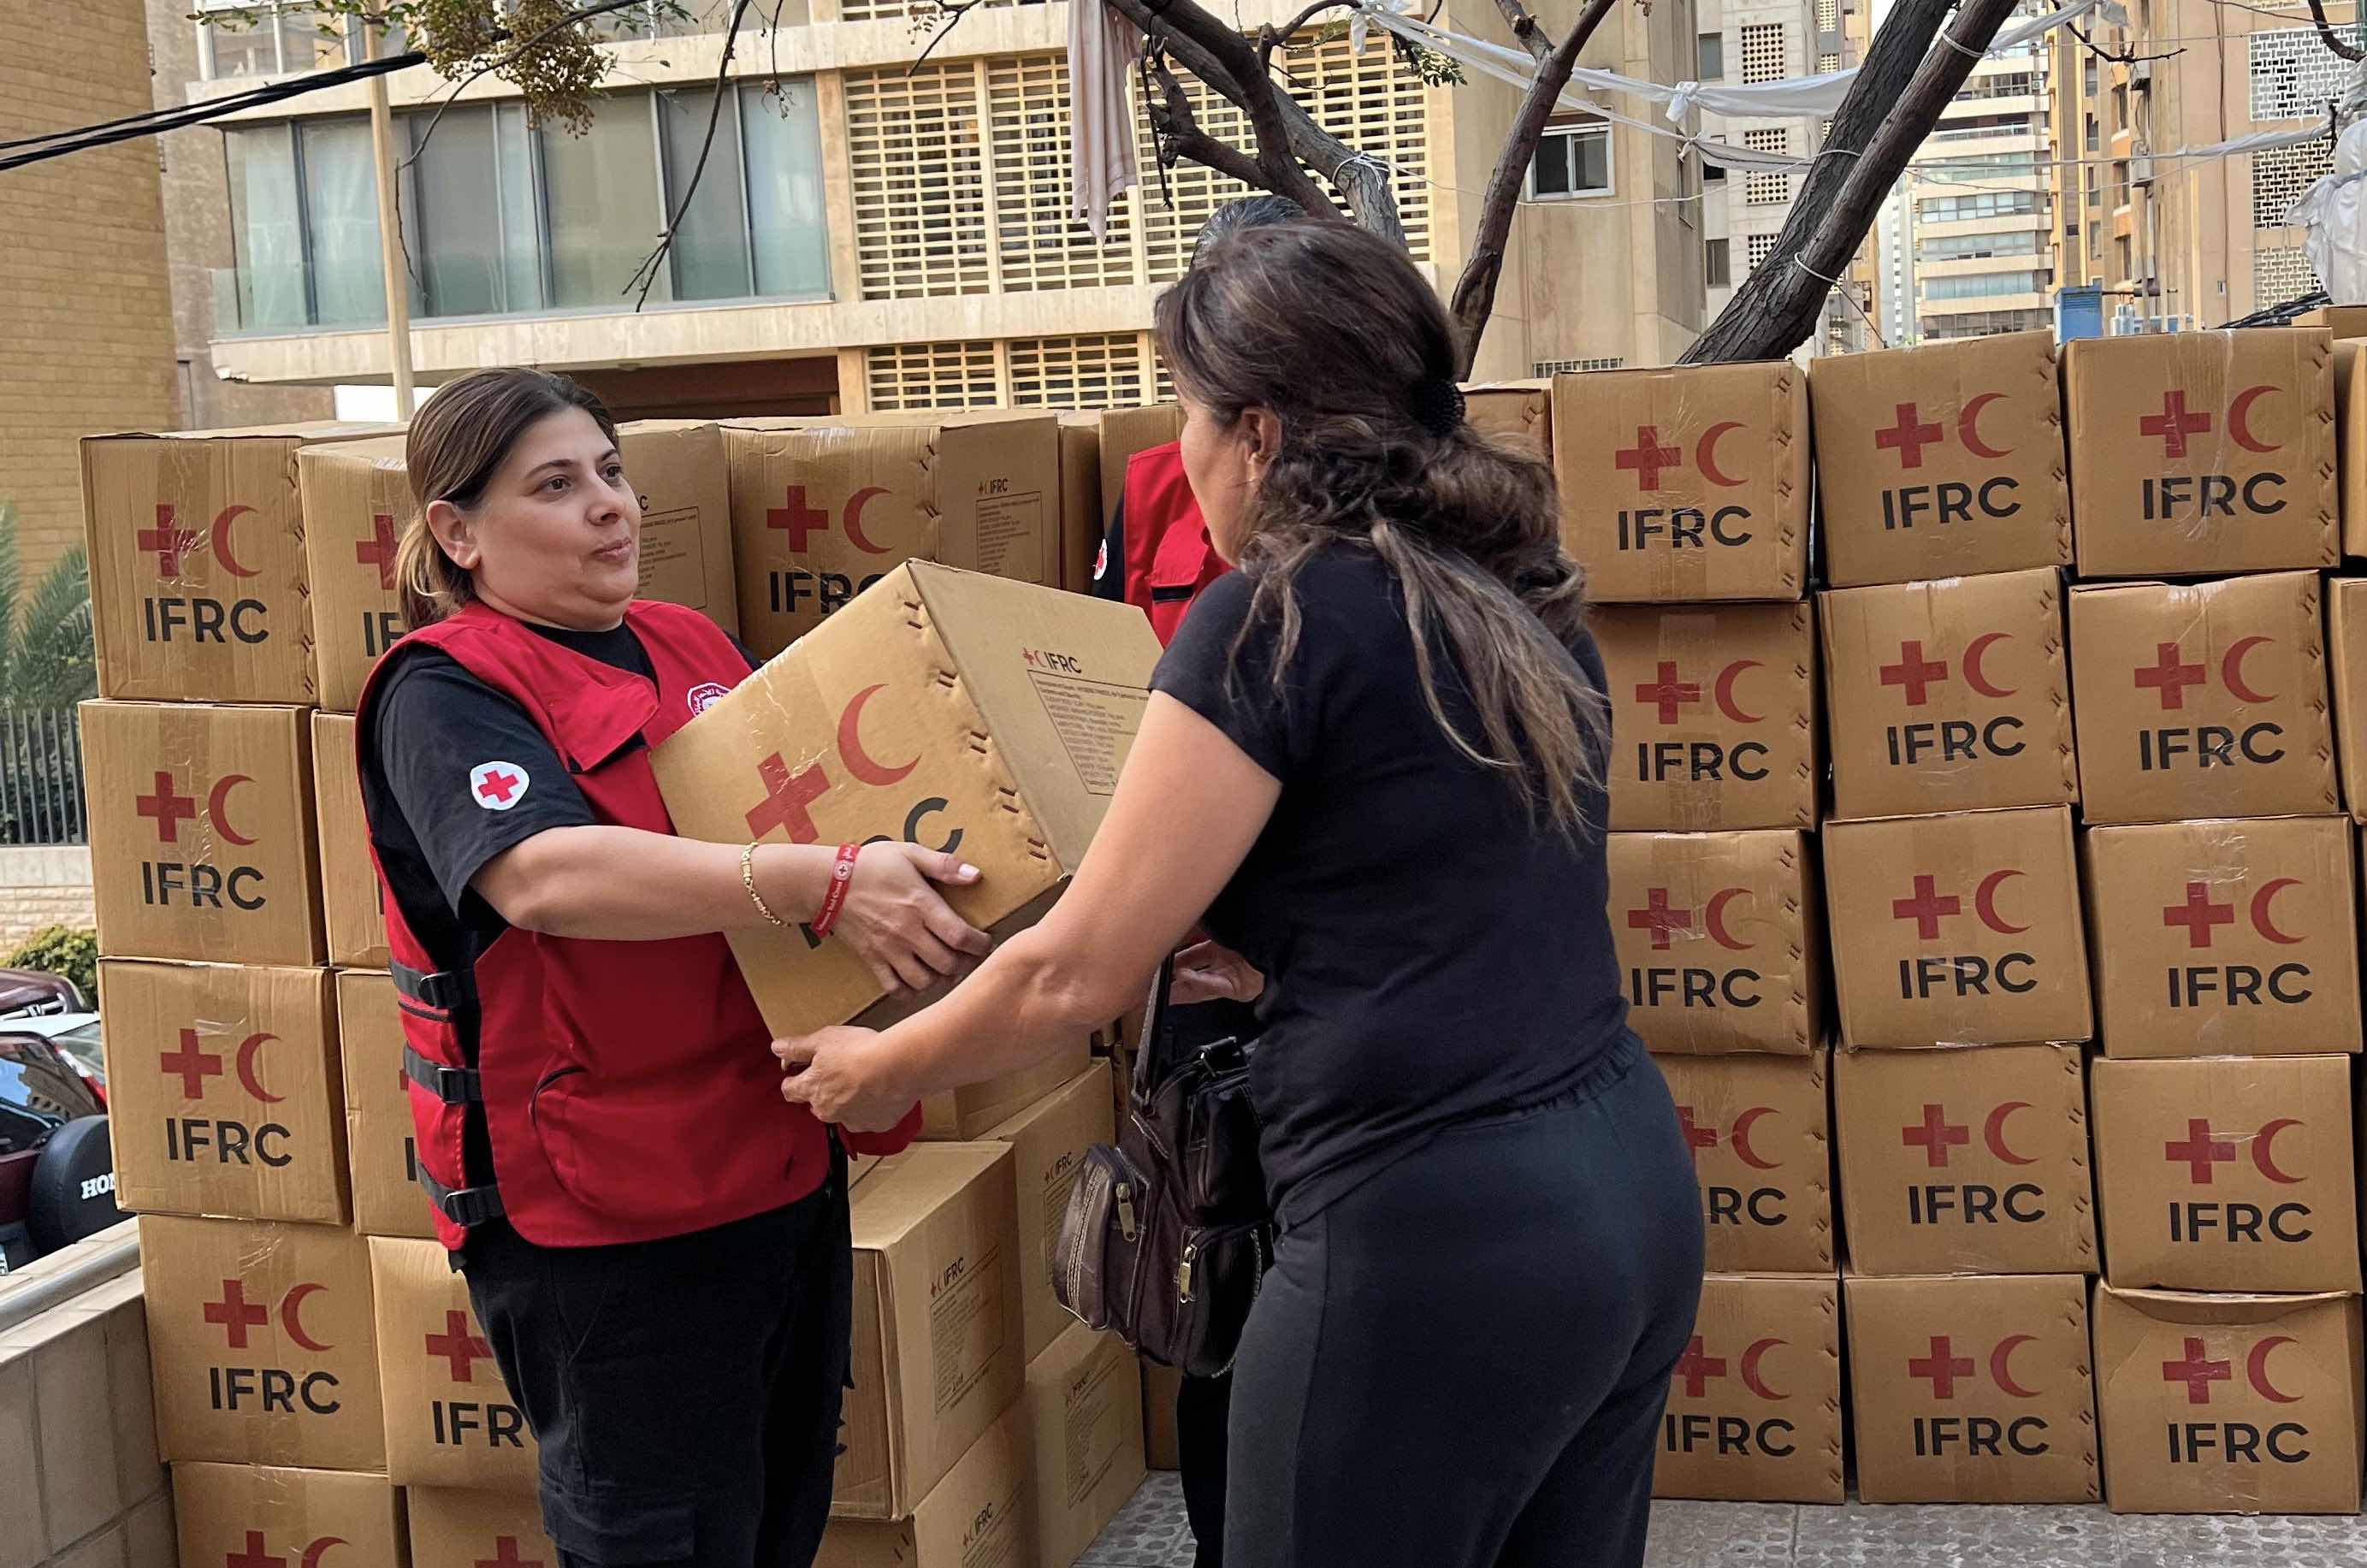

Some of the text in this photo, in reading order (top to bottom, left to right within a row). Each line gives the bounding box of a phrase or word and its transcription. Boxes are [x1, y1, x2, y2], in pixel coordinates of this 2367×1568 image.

[991, 478, 1009, 493] IFRC
[1883, 477, 2021, 530] IFRC
[2144, 473, 2287, 519] IFRC
[1618, 506, 1752, 550] IFRC
[770, 571, 886, 613] IFR
[145, 598, 269, 643] IFRC
[364, 612, 405, 657] IF
[1044, 652, 1082, 673] IFRC
[1639, 743, 1769, 781] IFRC
[1888, 717, 2026, 765] IFRC
[2140, 723, 2284, 770] IFRC
[143, 862, 265, 909] IFRC
[1632, 968, 1761, 1007] IFRC
[1900, 953, 2037, 998] IFRC
[2169, 963, 2311, 1007] IFRC
[167, 1118, 292, 1166] IFRC
[1700, 1186, 1787, 1226] RC
[1909, 1184, 2044, 1224] IFRC
[2169, 1203, 2312, 1242] IFRC
[944, 1257, 964, 1287] IFRC
[210, 1368, 340, 1414] IFRC
[433, 1401, 524, 1448] IFR
[1666, 1414, 1795, 1456] IFRC
[1914, 1417, 2049, 1456] IFRC
[2169, 1423, 2310, 1463] IFRC
[975, 1502, 993, 1535] IFRC
